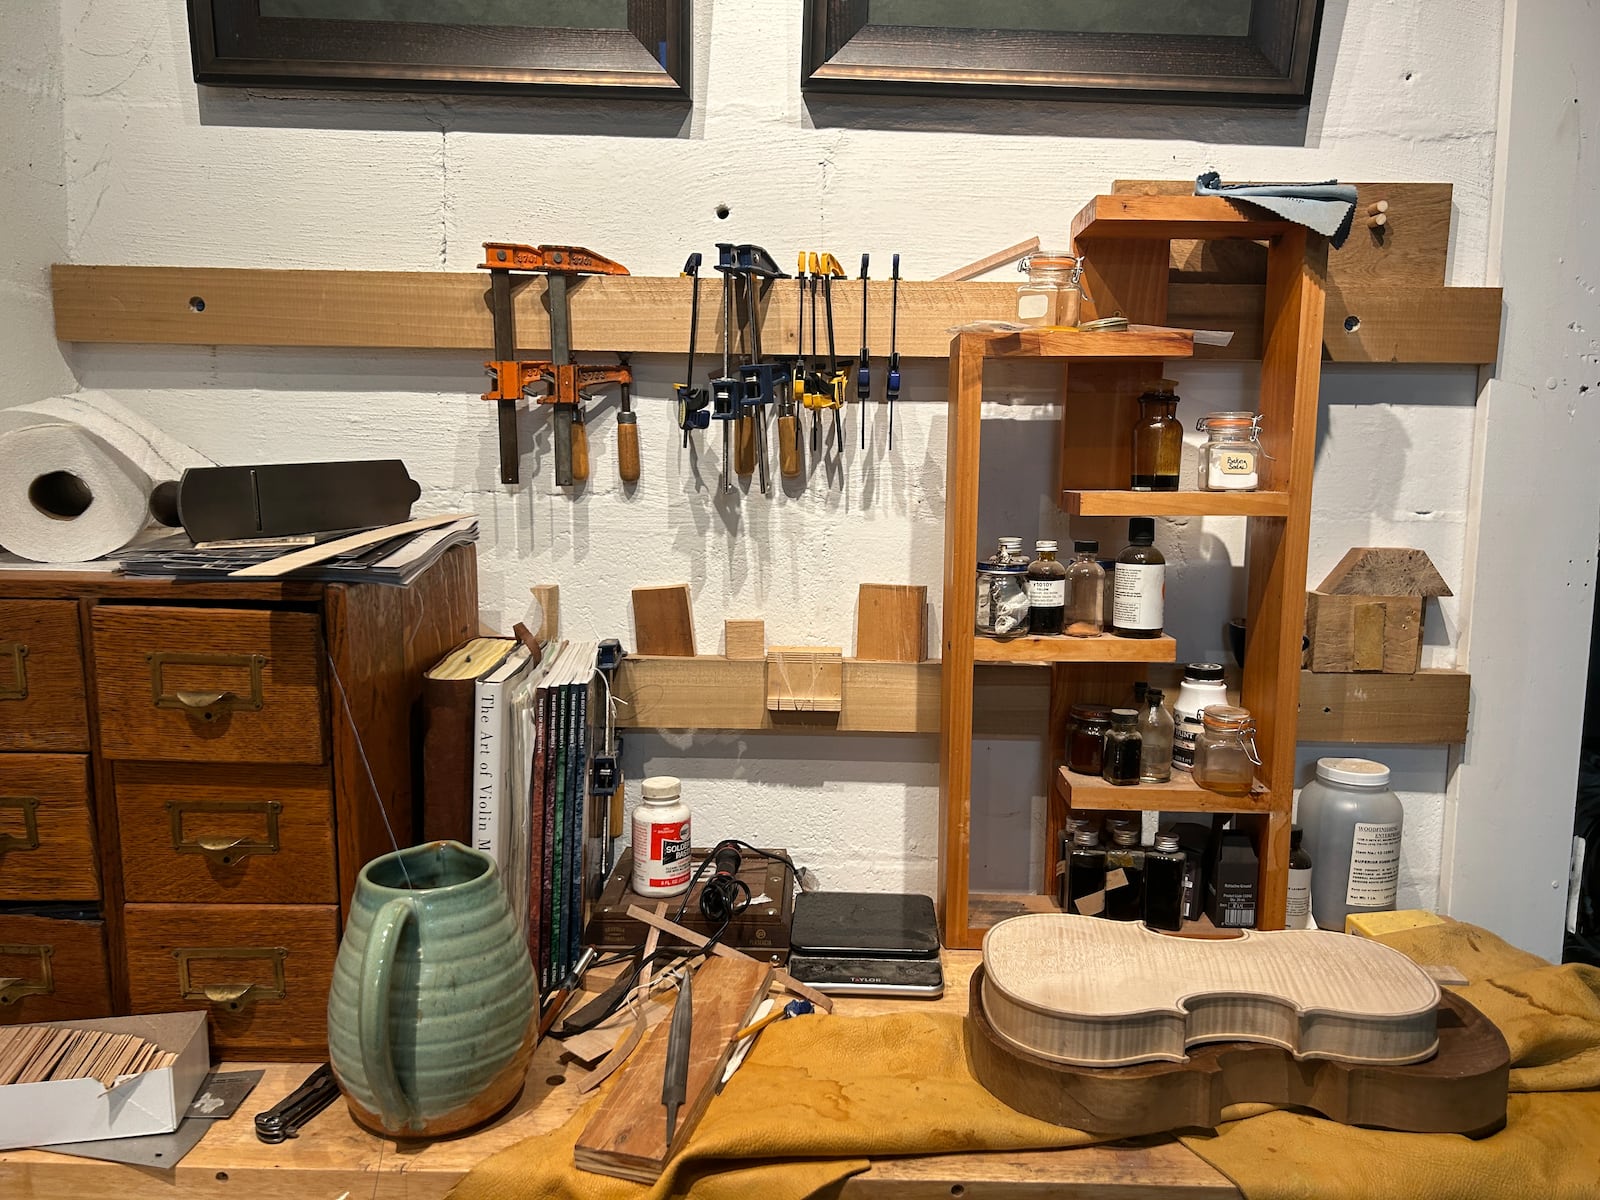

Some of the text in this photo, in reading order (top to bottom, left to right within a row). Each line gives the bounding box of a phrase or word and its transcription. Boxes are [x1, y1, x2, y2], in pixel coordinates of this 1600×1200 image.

[481, 694, 495, 723] The
[480, 730, 494, 754] Art
[480, 762, 493, 778] of
[479, 784, 492, 831] Violin
